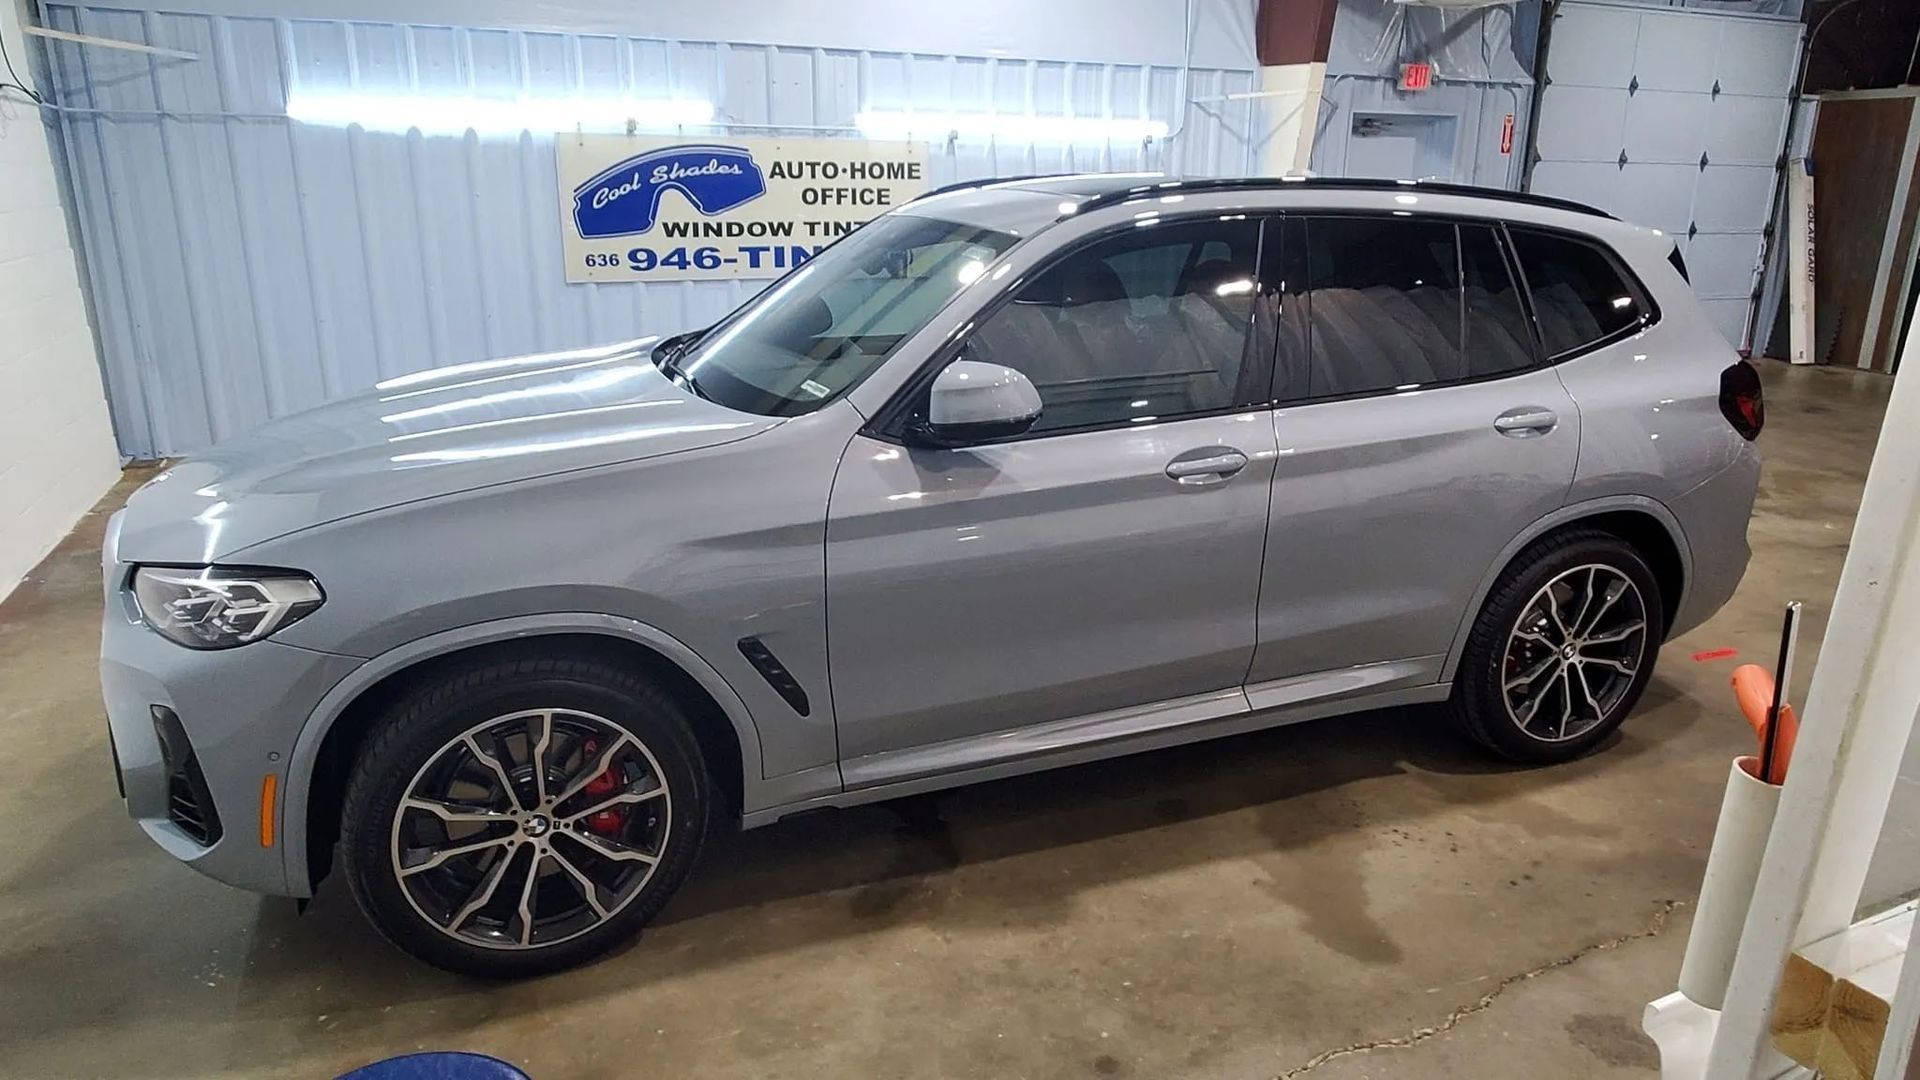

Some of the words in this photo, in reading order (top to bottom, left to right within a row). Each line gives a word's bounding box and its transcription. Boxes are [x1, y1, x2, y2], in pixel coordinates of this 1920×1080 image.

[1406, 65, 1429, 87] EXIT
[593, 172, 641, 209] Cool
[650, 158, 743, 184] Shades
[801, 188, 890, 205] OFFICE
[662, 221, 794, 238] WINDOW
[585, 253, 620, 267] 636
